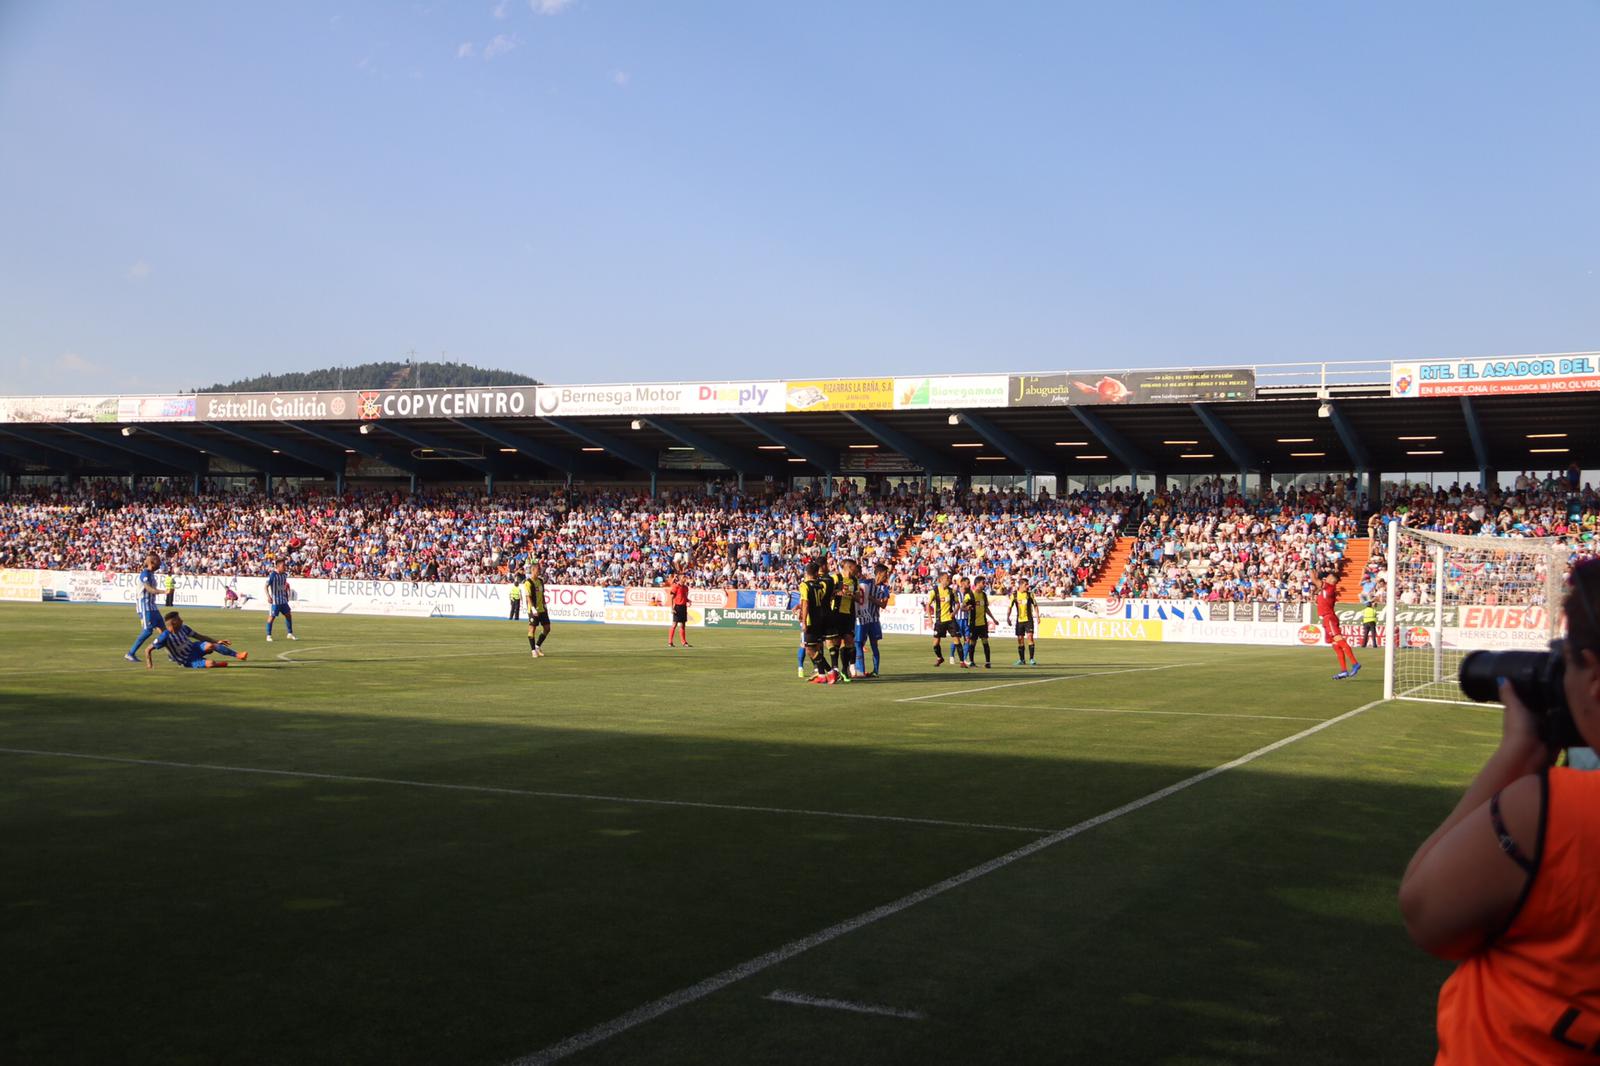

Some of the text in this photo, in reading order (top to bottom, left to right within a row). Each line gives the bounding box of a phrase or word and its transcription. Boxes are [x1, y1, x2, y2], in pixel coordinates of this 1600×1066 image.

[1420, 364, 1455, 380] RTE.
[1458, 363, 1480, 379] EL
[1481, 360, 1556, 378] ASADOR
[1559, 358, 1595, 374] DEL
[823, 383, 853, 393] PIZARRAS
[853, 383, 862, 393] LA
[1421, 386, 1433, 394] EN
[561, 387, 682, 406] Bernesga Motor
[207, 398, 267, 418] Estrella
[270, 397, 327, 418] Galicia
[383, 391, 525, 416] COPYCENTRO
[327, 580, 501, 600] HERRERO BRIGANTINA
[1126, 604, 1205, 621] DIANA
[1212, 604, 1227, 612] AC
[1236, 604, 1252, 612] AC
[1261, 604, 1275, 612] AC
[723, 610, 800, 622] Embutidos La Enci
[881, 623, 915, 632] OSMOS
[1054, 620, 1147, 638] ALIMERKA
[1191, 624, 1289, 639] Flores Prado
[1512, 631, 1545, 640] BRIGA
